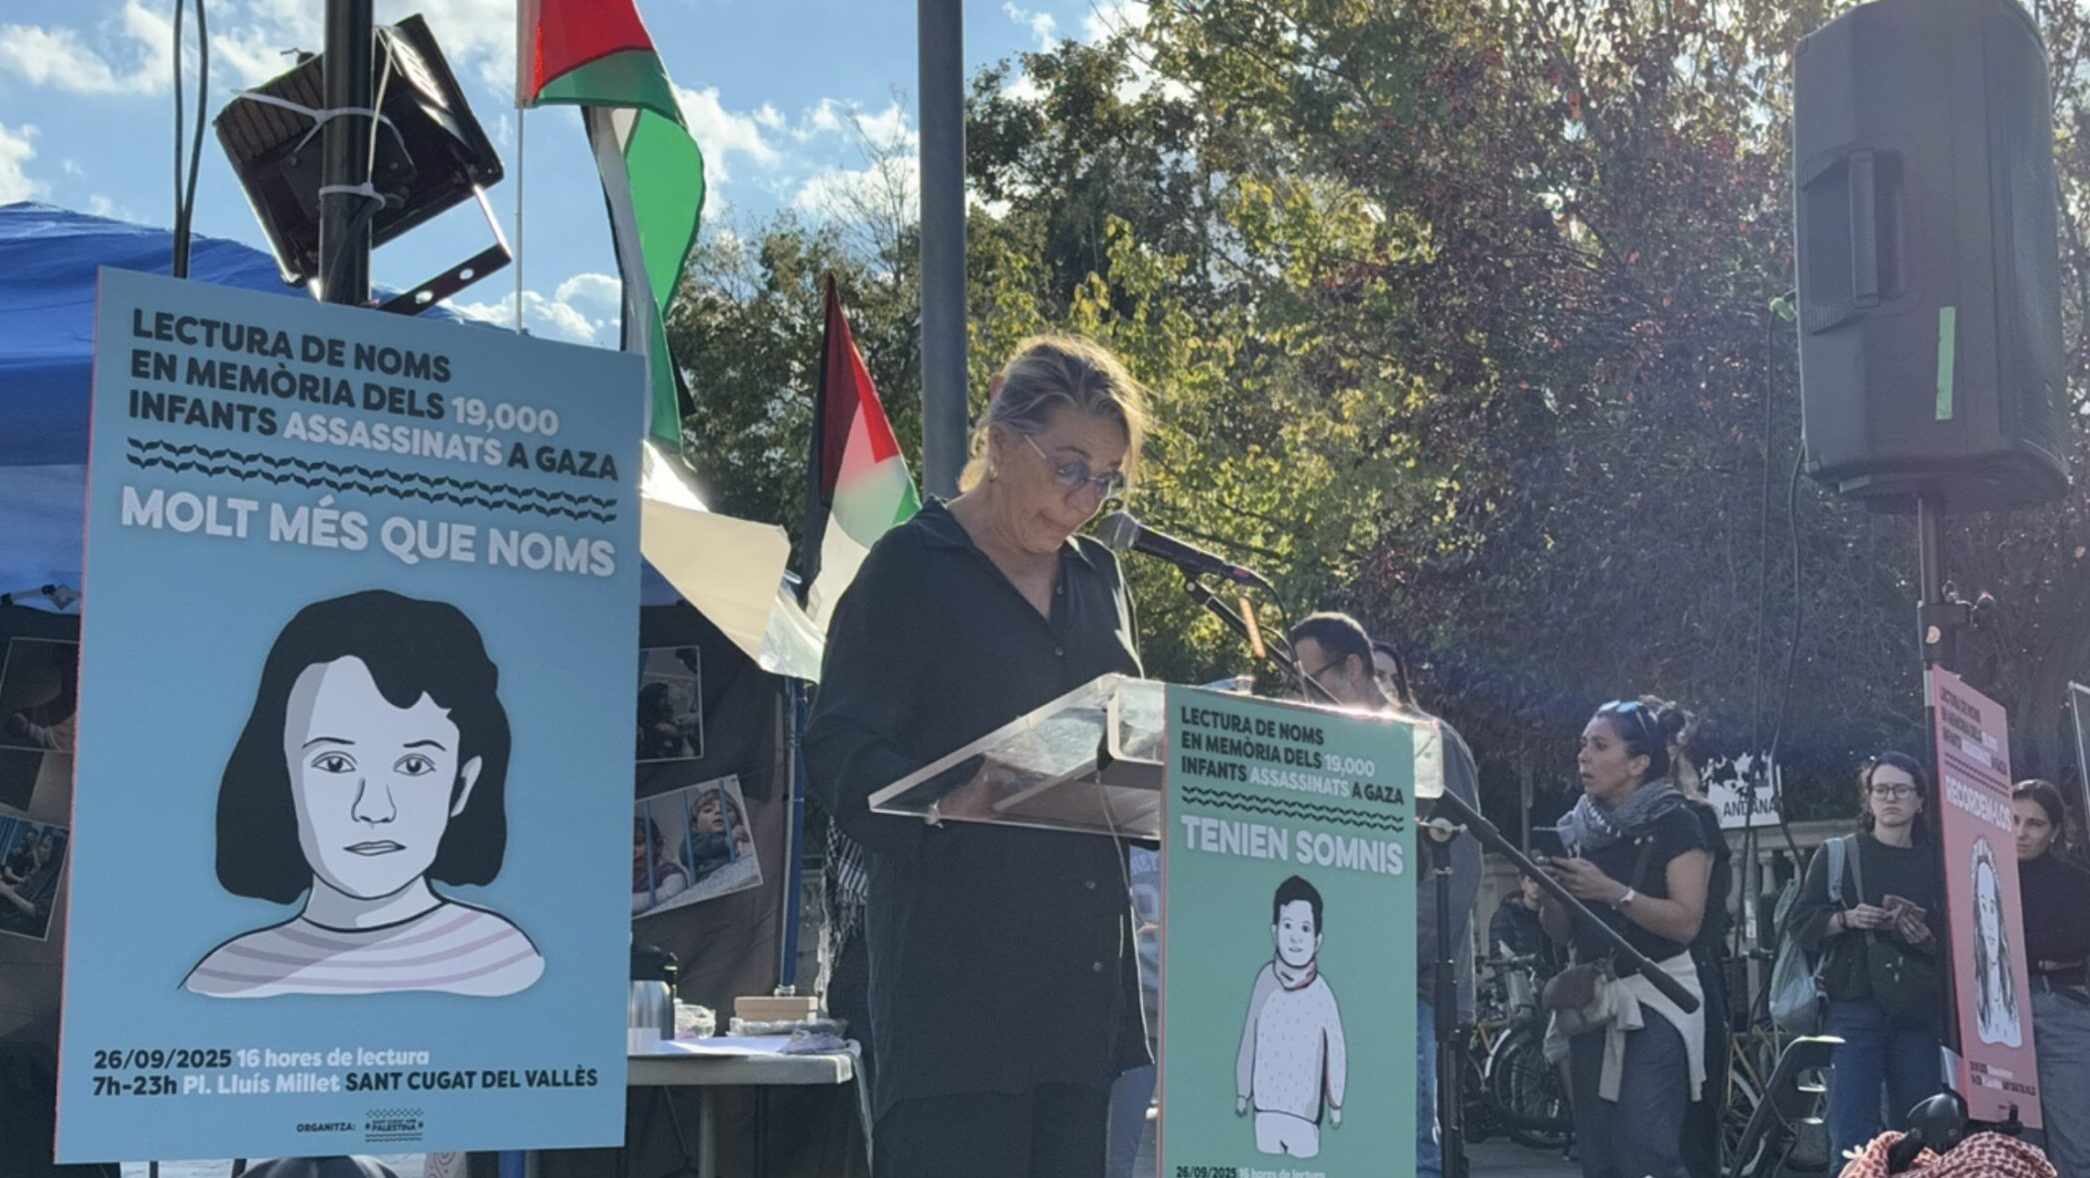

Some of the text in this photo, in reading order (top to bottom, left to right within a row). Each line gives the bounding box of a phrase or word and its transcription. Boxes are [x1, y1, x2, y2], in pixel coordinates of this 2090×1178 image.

[132, 308, 452, 383] LECTURA DE NOMS
[131, 349, 559, 436] EN MEMÒRIA DELS 19,000
[129, 390, 619, 481] INFANTS ASSASSINATS A GAZA
[121, 485, 615, 577] MOLT MÉS QUE NOMS
[1181, 706, 1324, 746] LECTURA DE NOMS
[1181, 731, 1375, 778] EN MEMÒRIA DELS 19,000
[1181, 755, 1404, 805] INFANTS ASSASSINATS A GAZA
[1181, 815, 1404, 875] TENIEN SOMNIS
[93, 1047, 429, 1070] 26/09/2025 16 hores de lectura
[93, 1064, 598, 1097] 7h-23h Pl. Lluís Millet SANT CUGAT DEL VALLÈS
